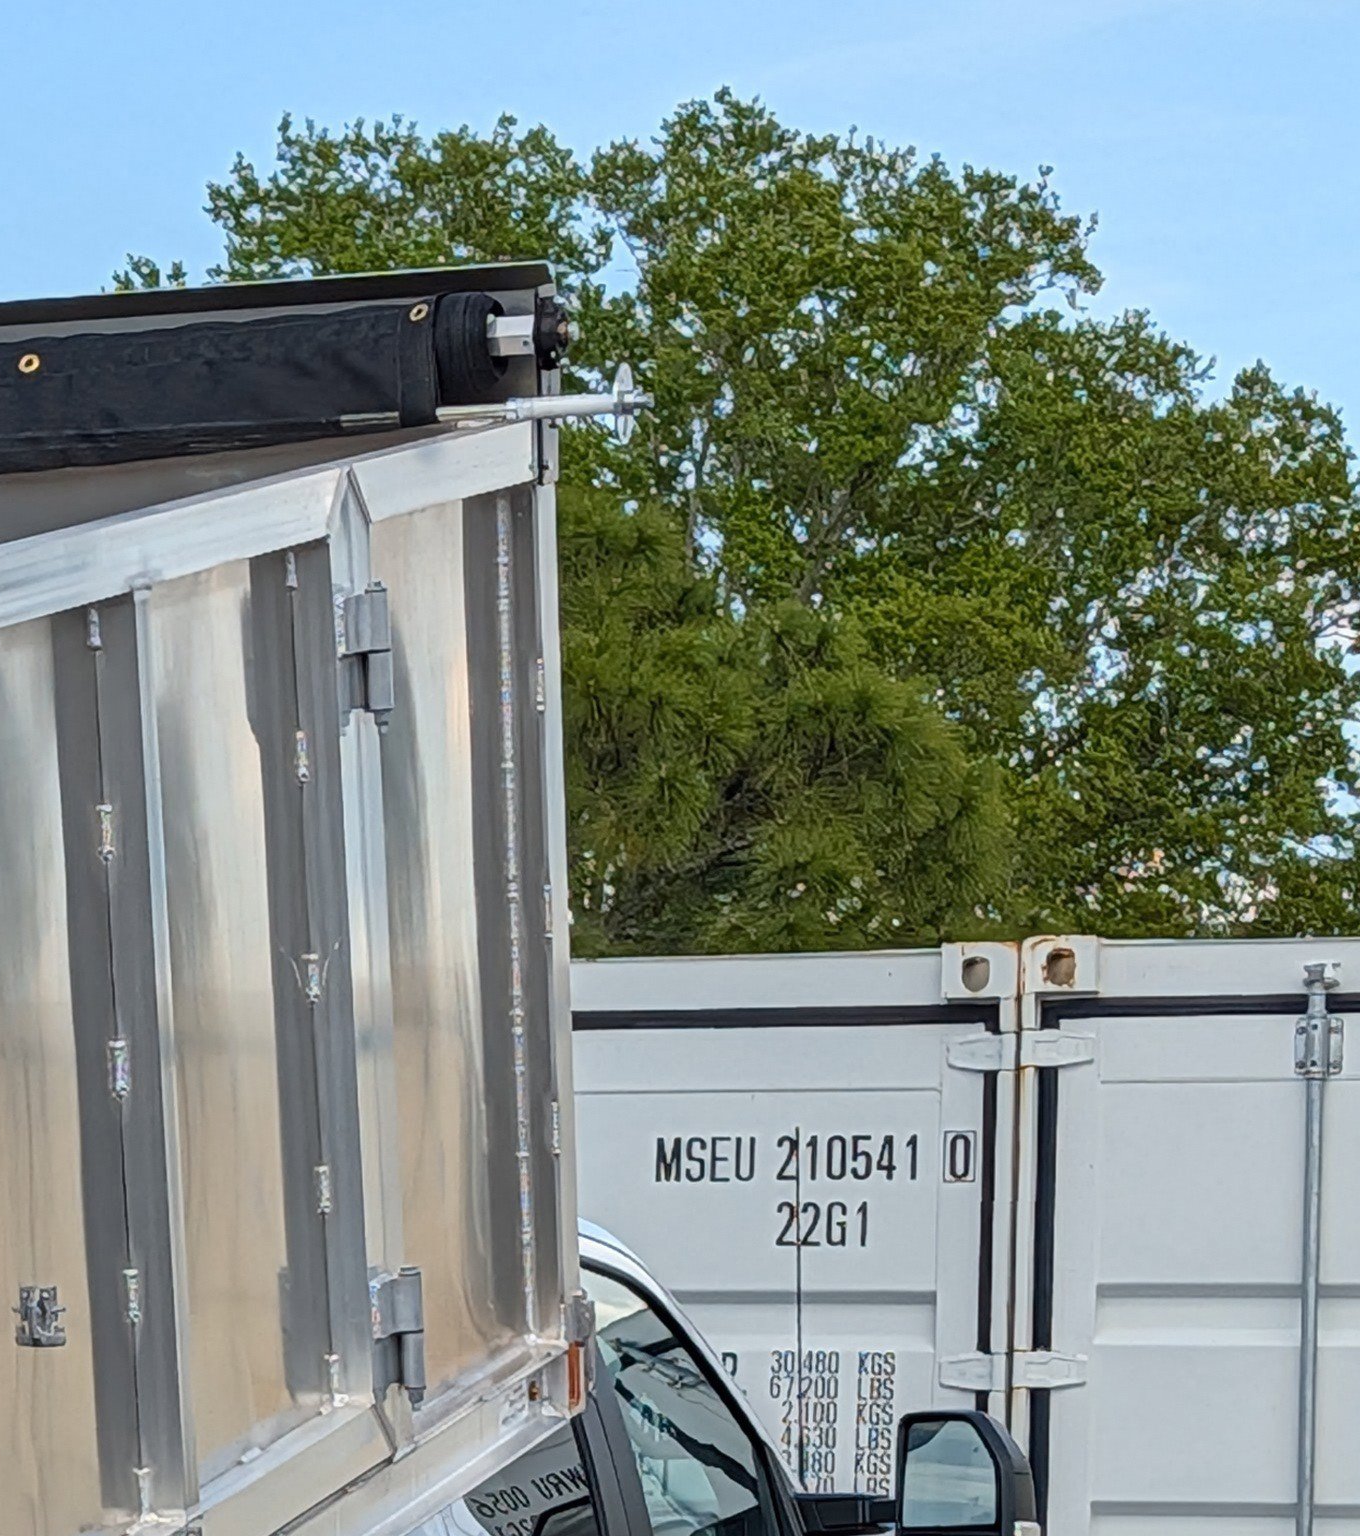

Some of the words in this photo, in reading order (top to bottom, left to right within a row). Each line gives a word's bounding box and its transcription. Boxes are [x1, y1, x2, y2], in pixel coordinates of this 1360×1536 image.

[655, 1136, 756, 1183] MSEU
[776, 1133, 918, 1182] 210541
[775, 1201, 868, 1247] 22G1
[857, 1350, 896, 1377] KGS
[857, 1375, 895, 1402] LBS
[856, 1400, 894, 1427] KGS
[855, 1425, 892, 1451] LBS
[854, 1450, 892, 1476] KGS
